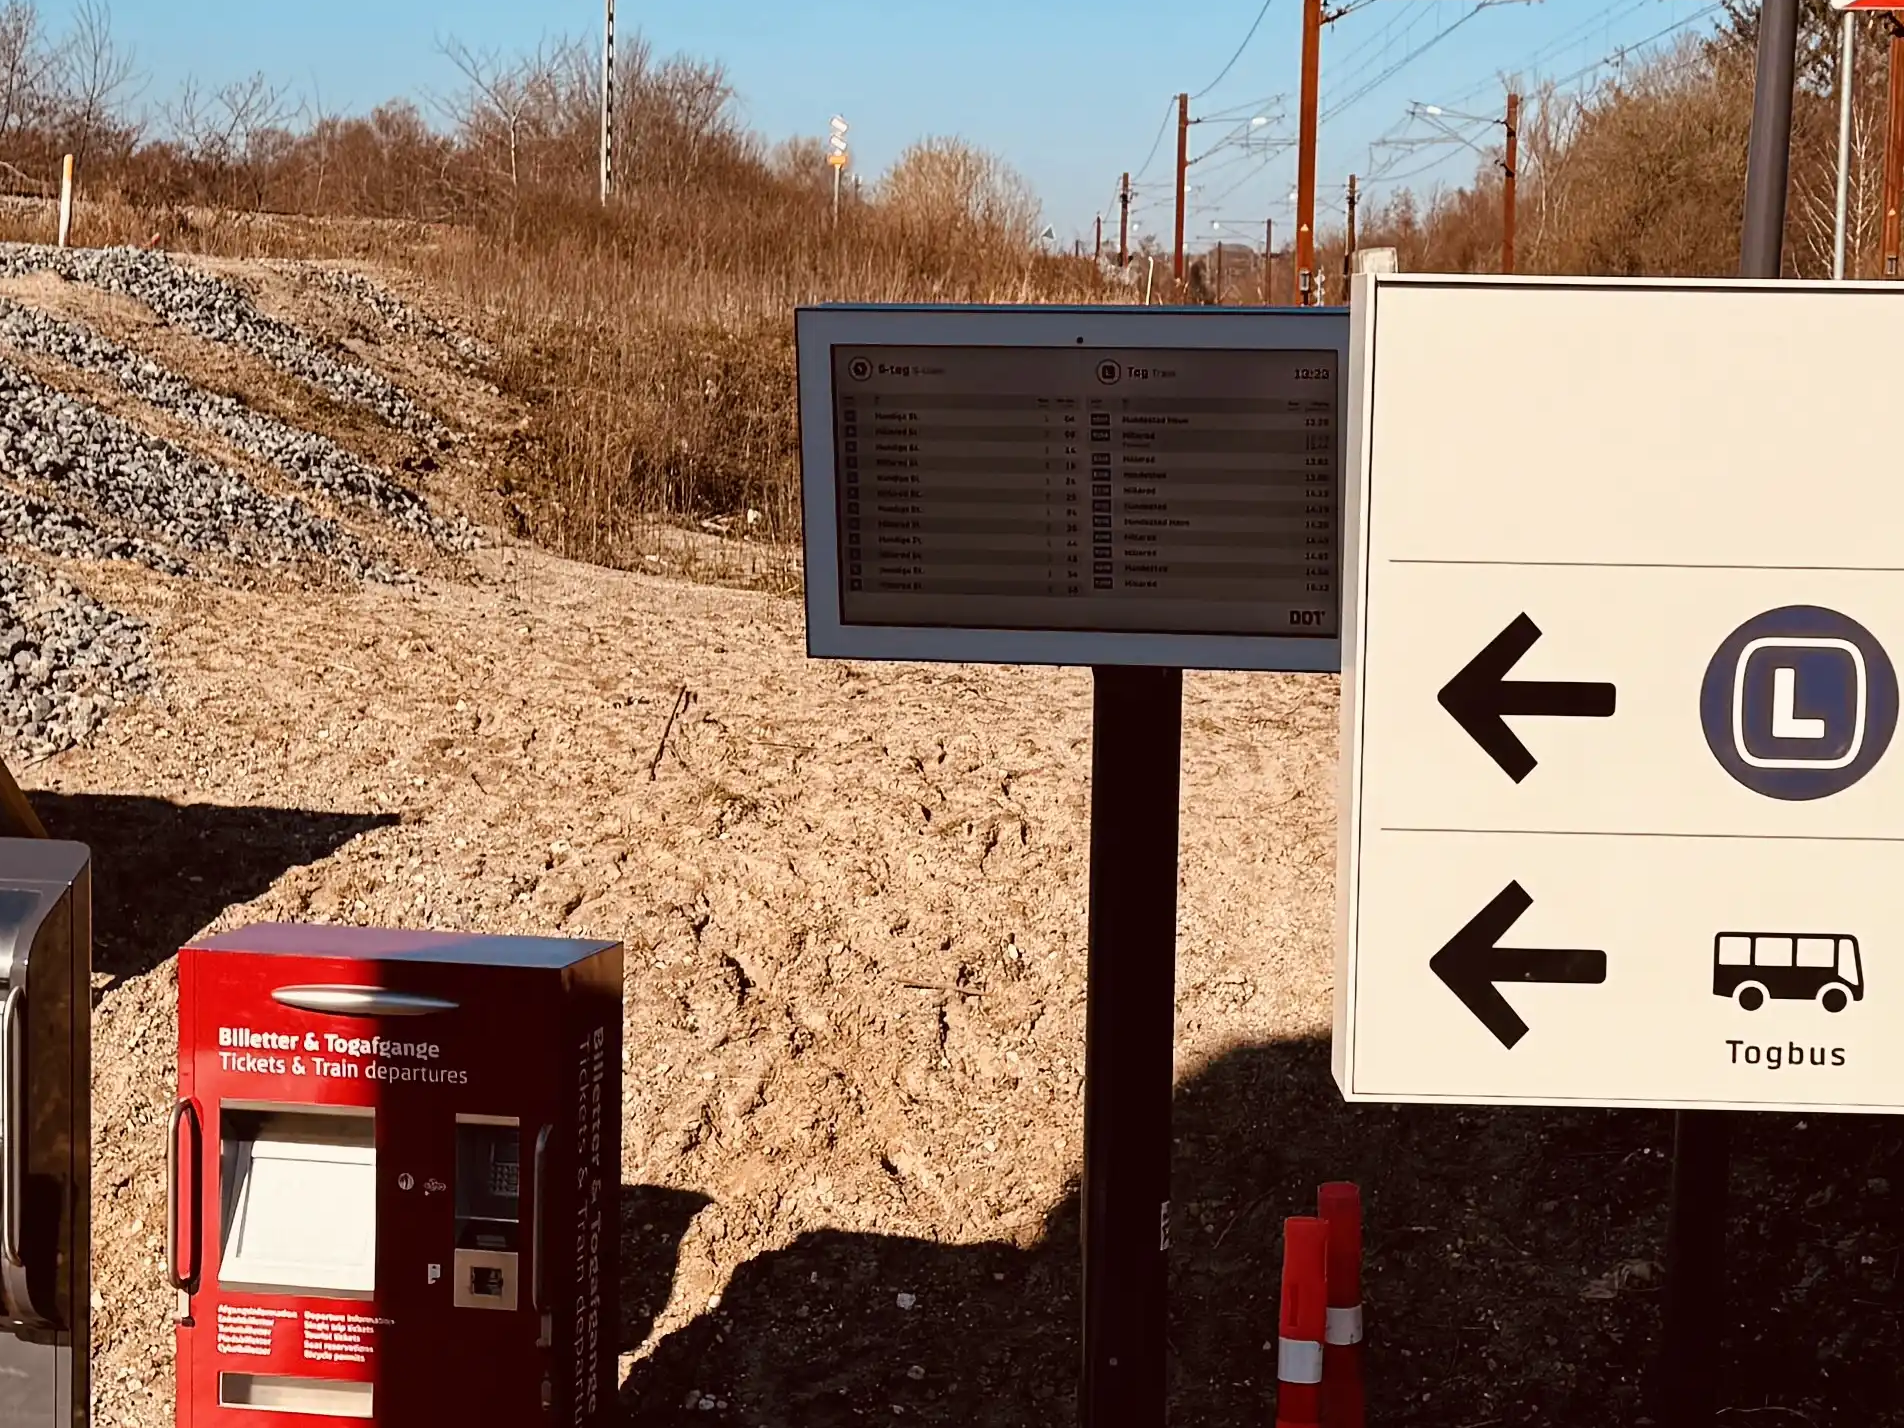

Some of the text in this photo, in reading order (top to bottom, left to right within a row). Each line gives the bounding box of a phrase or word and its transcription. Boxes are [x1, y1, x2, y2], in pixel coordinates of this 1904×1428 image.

[219, 1027, 440, 1061] Billetter & Togafgange
[1725, 1040, 1846, 1070] Togbus
[219, 1051, 468, 1085] Tickets & Train departures
